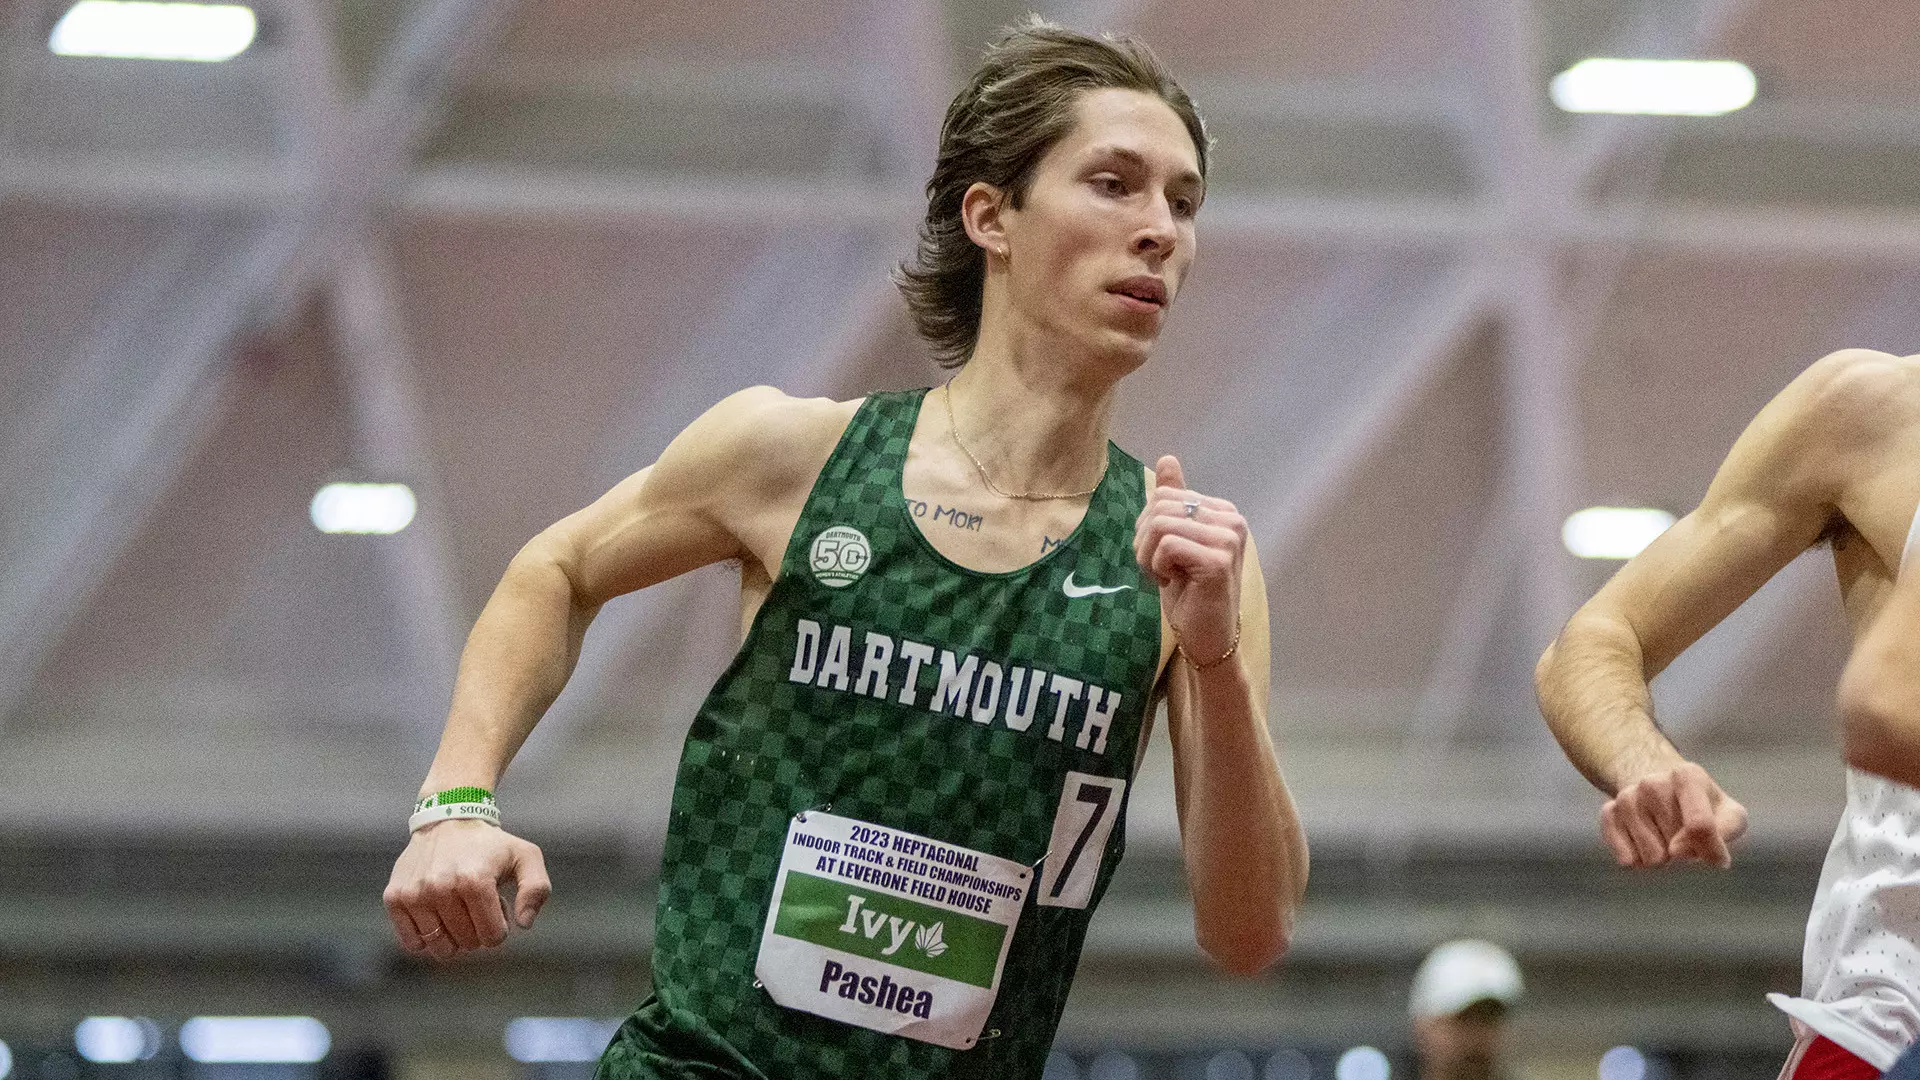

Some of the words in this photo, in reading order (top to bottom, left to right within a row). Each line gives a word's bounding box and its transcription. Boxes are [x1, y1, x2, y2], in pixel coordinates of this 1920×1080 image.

[826, 531, 861, 541] DARTMOUTH
[933, 505, 982, 532] MORI
[789, 619, 1122, 754] DARTMOUTH
[793, 832, 840, 854] INDOOR
[843, 843, 883, 864] TRACK
[885, 856, 895, 868] &
[897, 857, 928, 875] FIELD
[929, 865, 1023, 902] CHAMPIONSHIPS
[850, 825, 889, 848] 2023
[892, 836, 980, 872] HEPTAGONAL
[1050, 783, 1114, 898] 7
[816, 855, 837, 872] AT
[838, 862, 909, 893] LEVERONE
[910, 879, 945, 901] FIELD
[947, 890, 993, 915] HOUSE
[839, 894, 916, 956] Ivy
[819, 960, 934, 1020] Pashea
